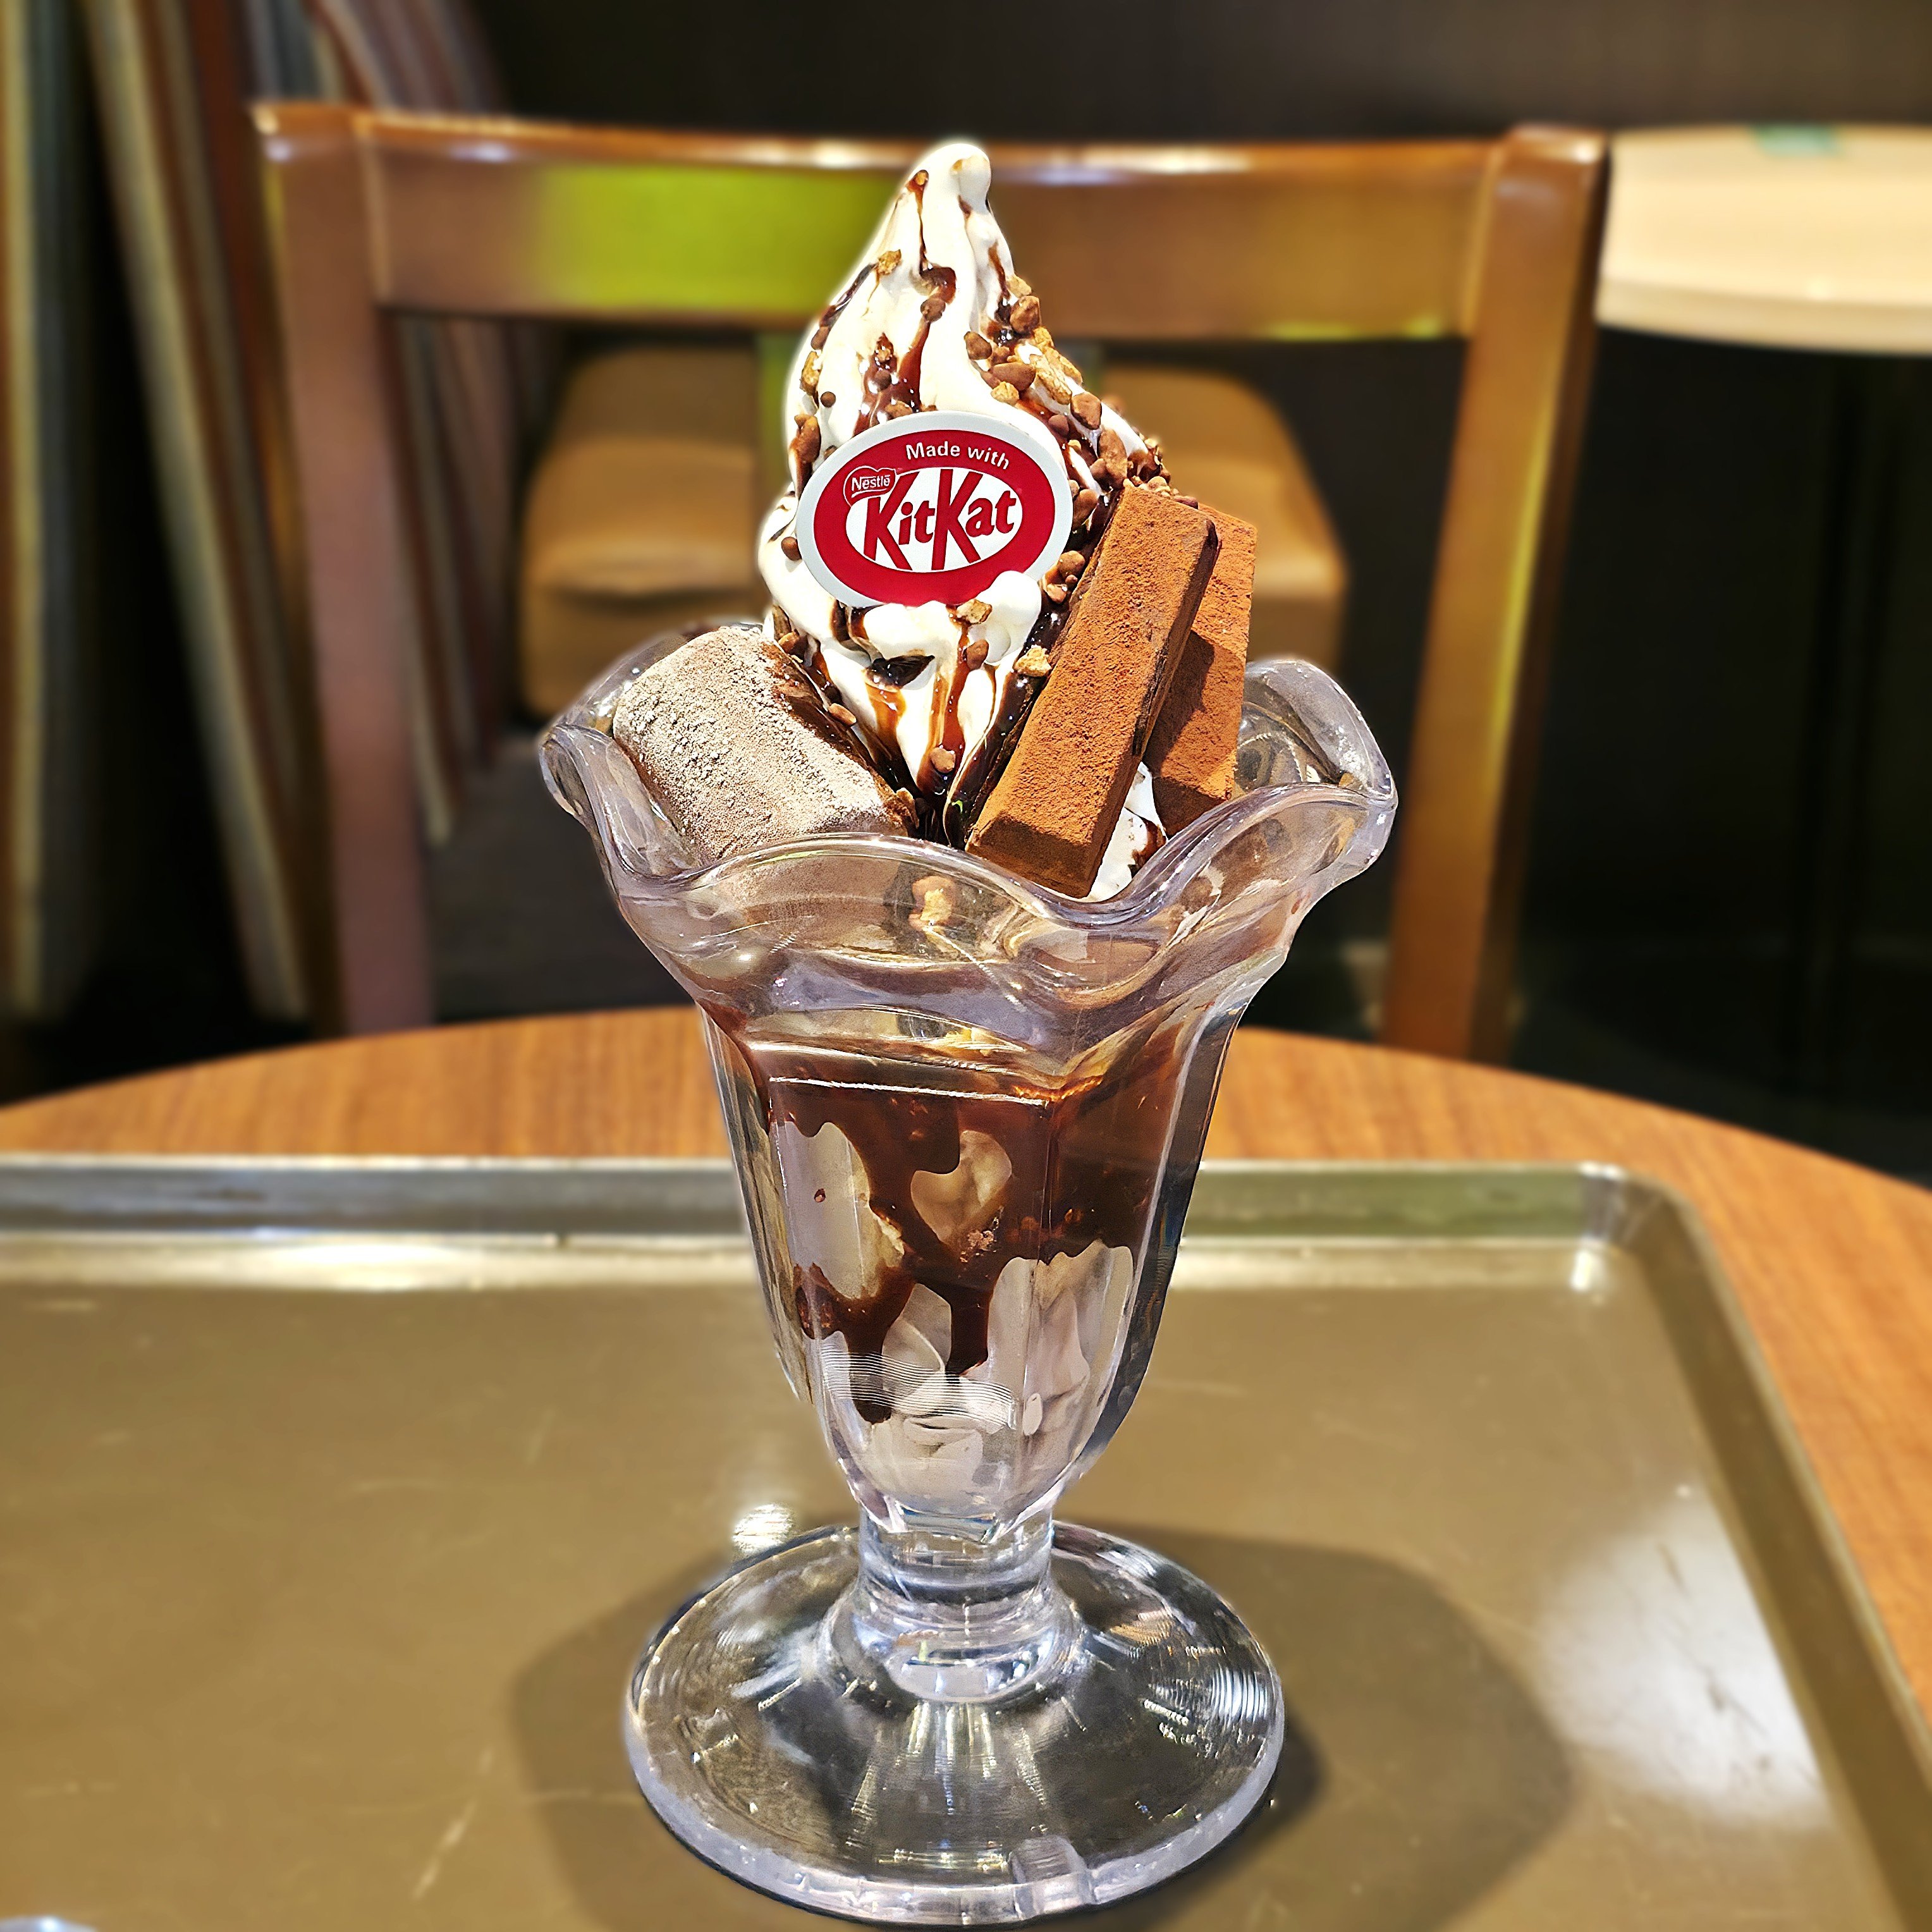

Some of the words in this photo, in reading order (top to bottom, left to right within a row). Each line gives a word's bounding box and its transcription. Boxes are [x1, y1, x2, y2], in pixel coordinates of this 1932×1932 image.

[906, 441, 960, 460] Made
[968, 446, 1009, 470] with
[864, 469, 1017, 570] KitKat
